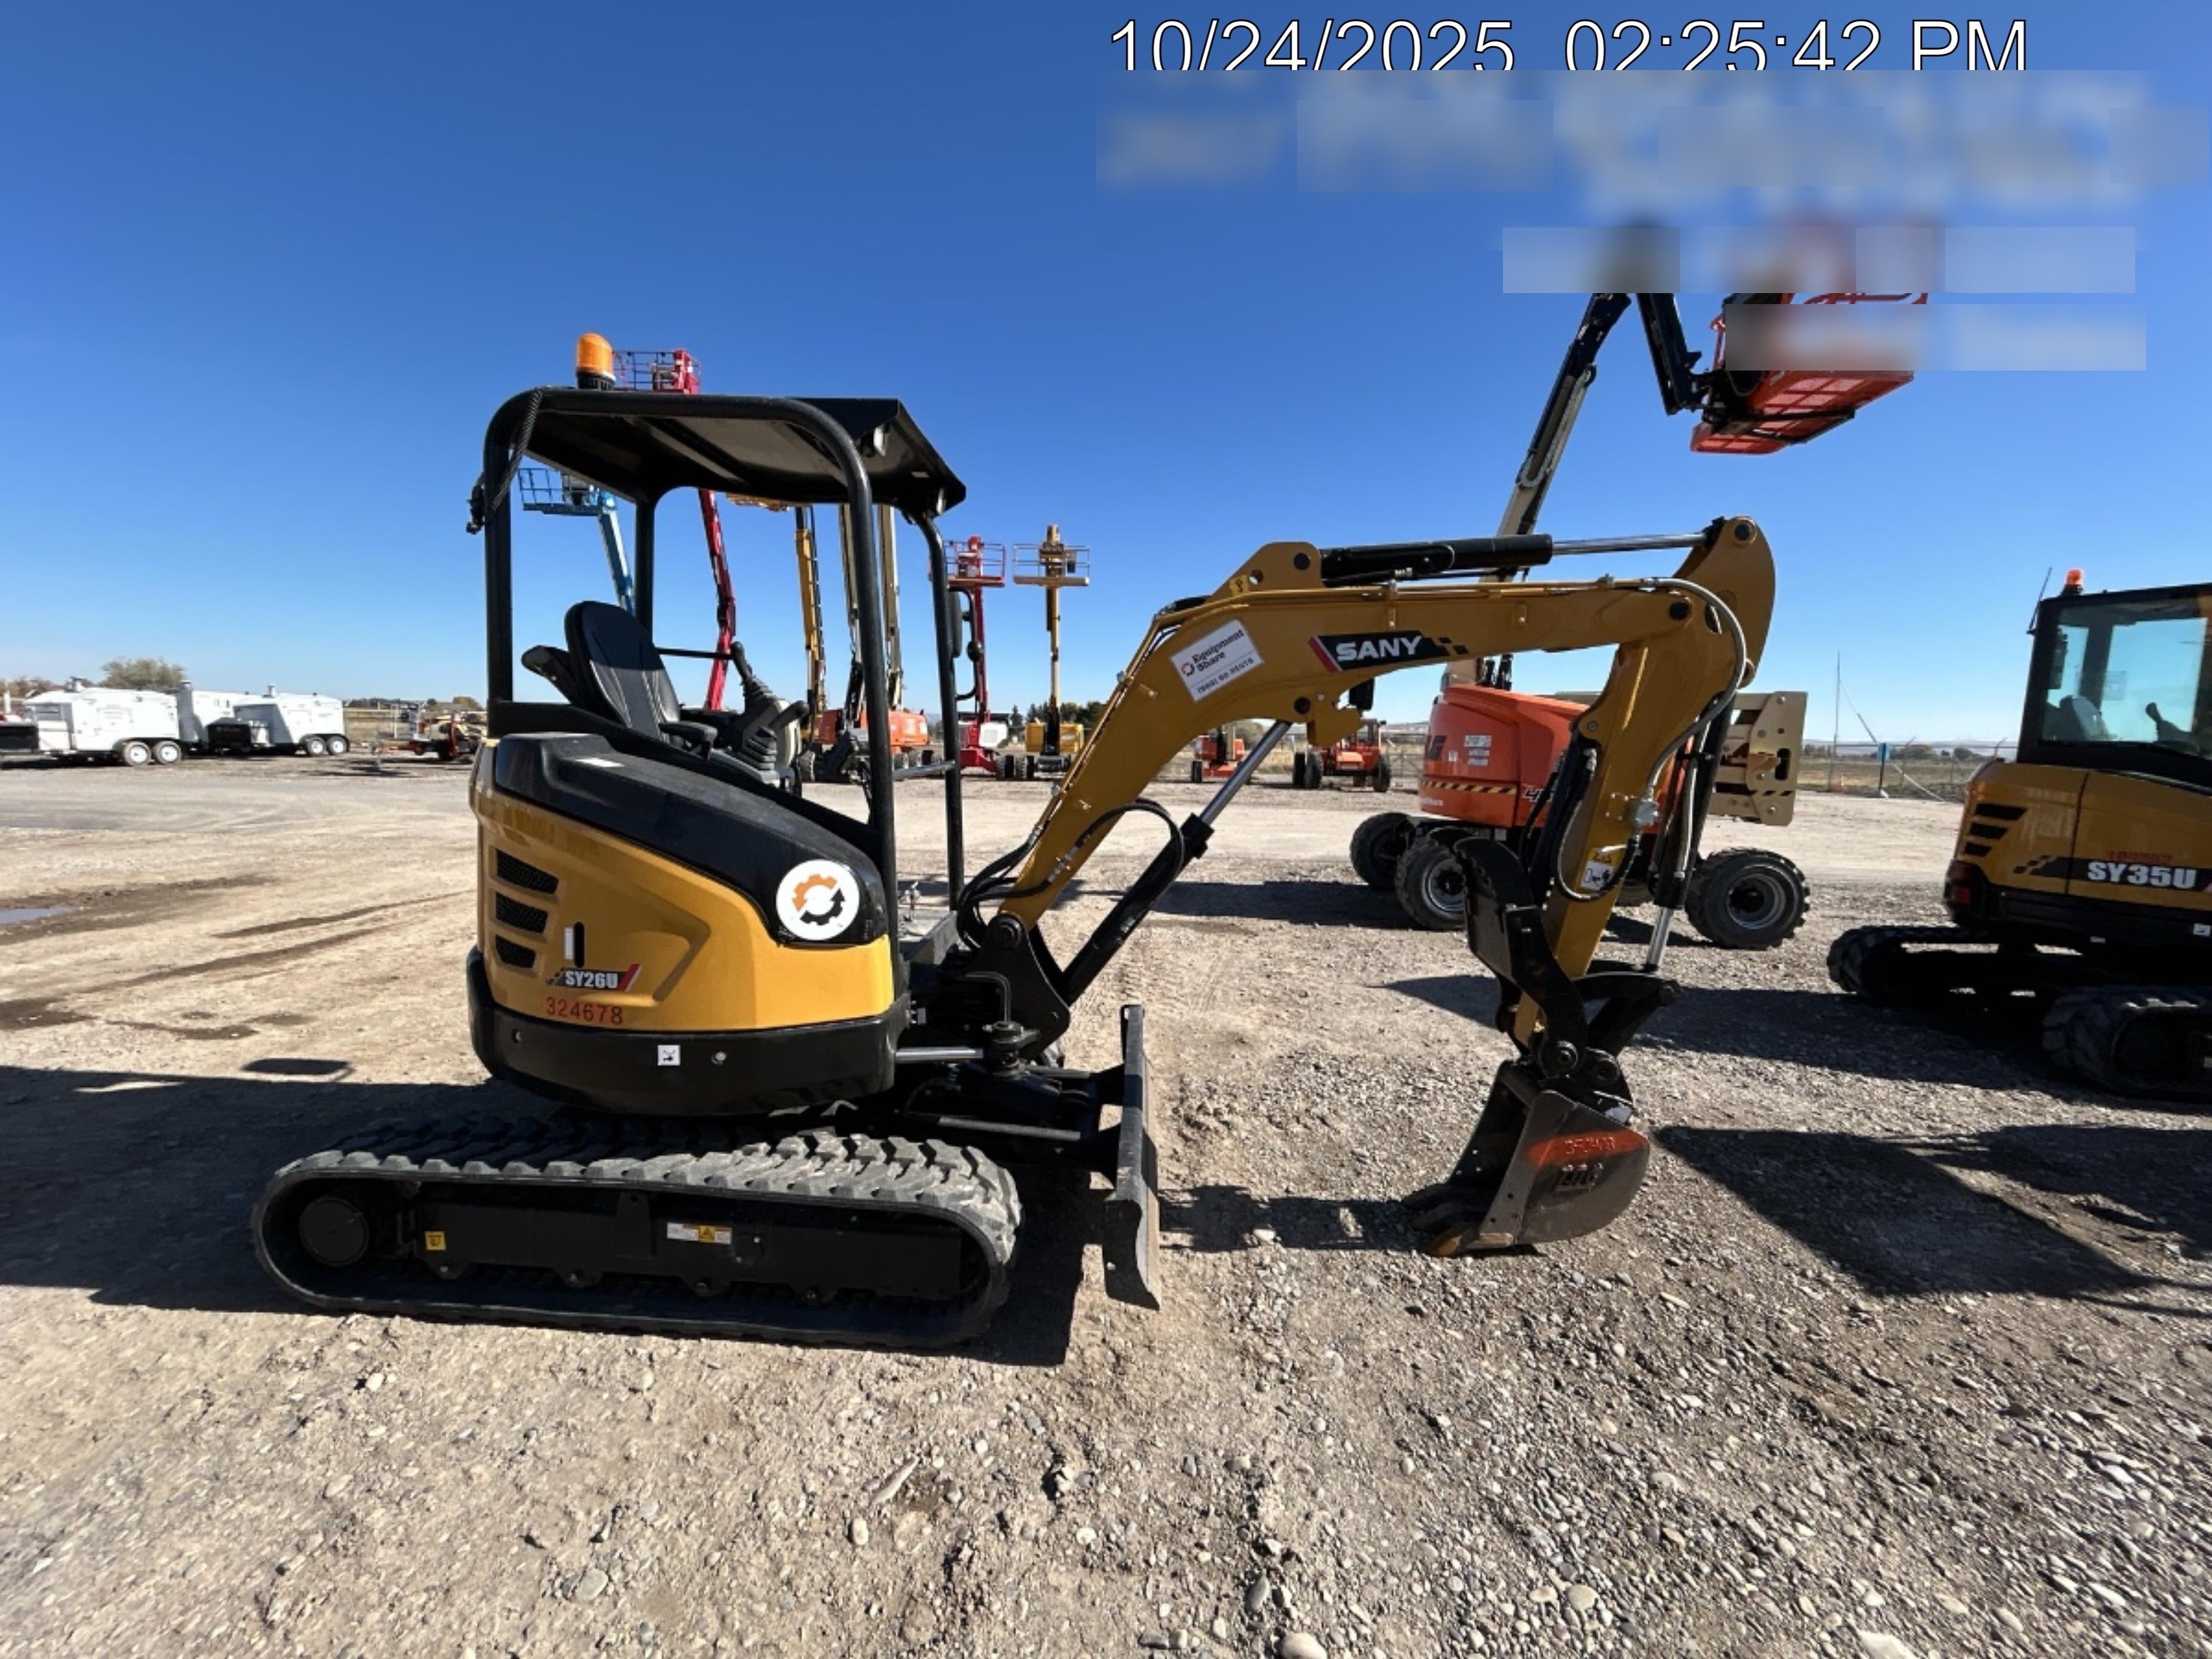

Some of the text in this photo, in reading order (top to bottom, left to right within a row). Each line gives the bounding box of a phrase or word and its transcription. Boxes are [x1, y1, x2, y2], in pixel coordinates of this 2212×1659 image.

[1192, 629, 1245, 664] Equipment
[1336, 635, 1422, 661] SANY
[1197, 651, 1226, 672] Share
[2087, 861, 2197, 890] SY35U
[565, 970, 619, 989] SY26U
[546, 996, 623, 1026] 324678
